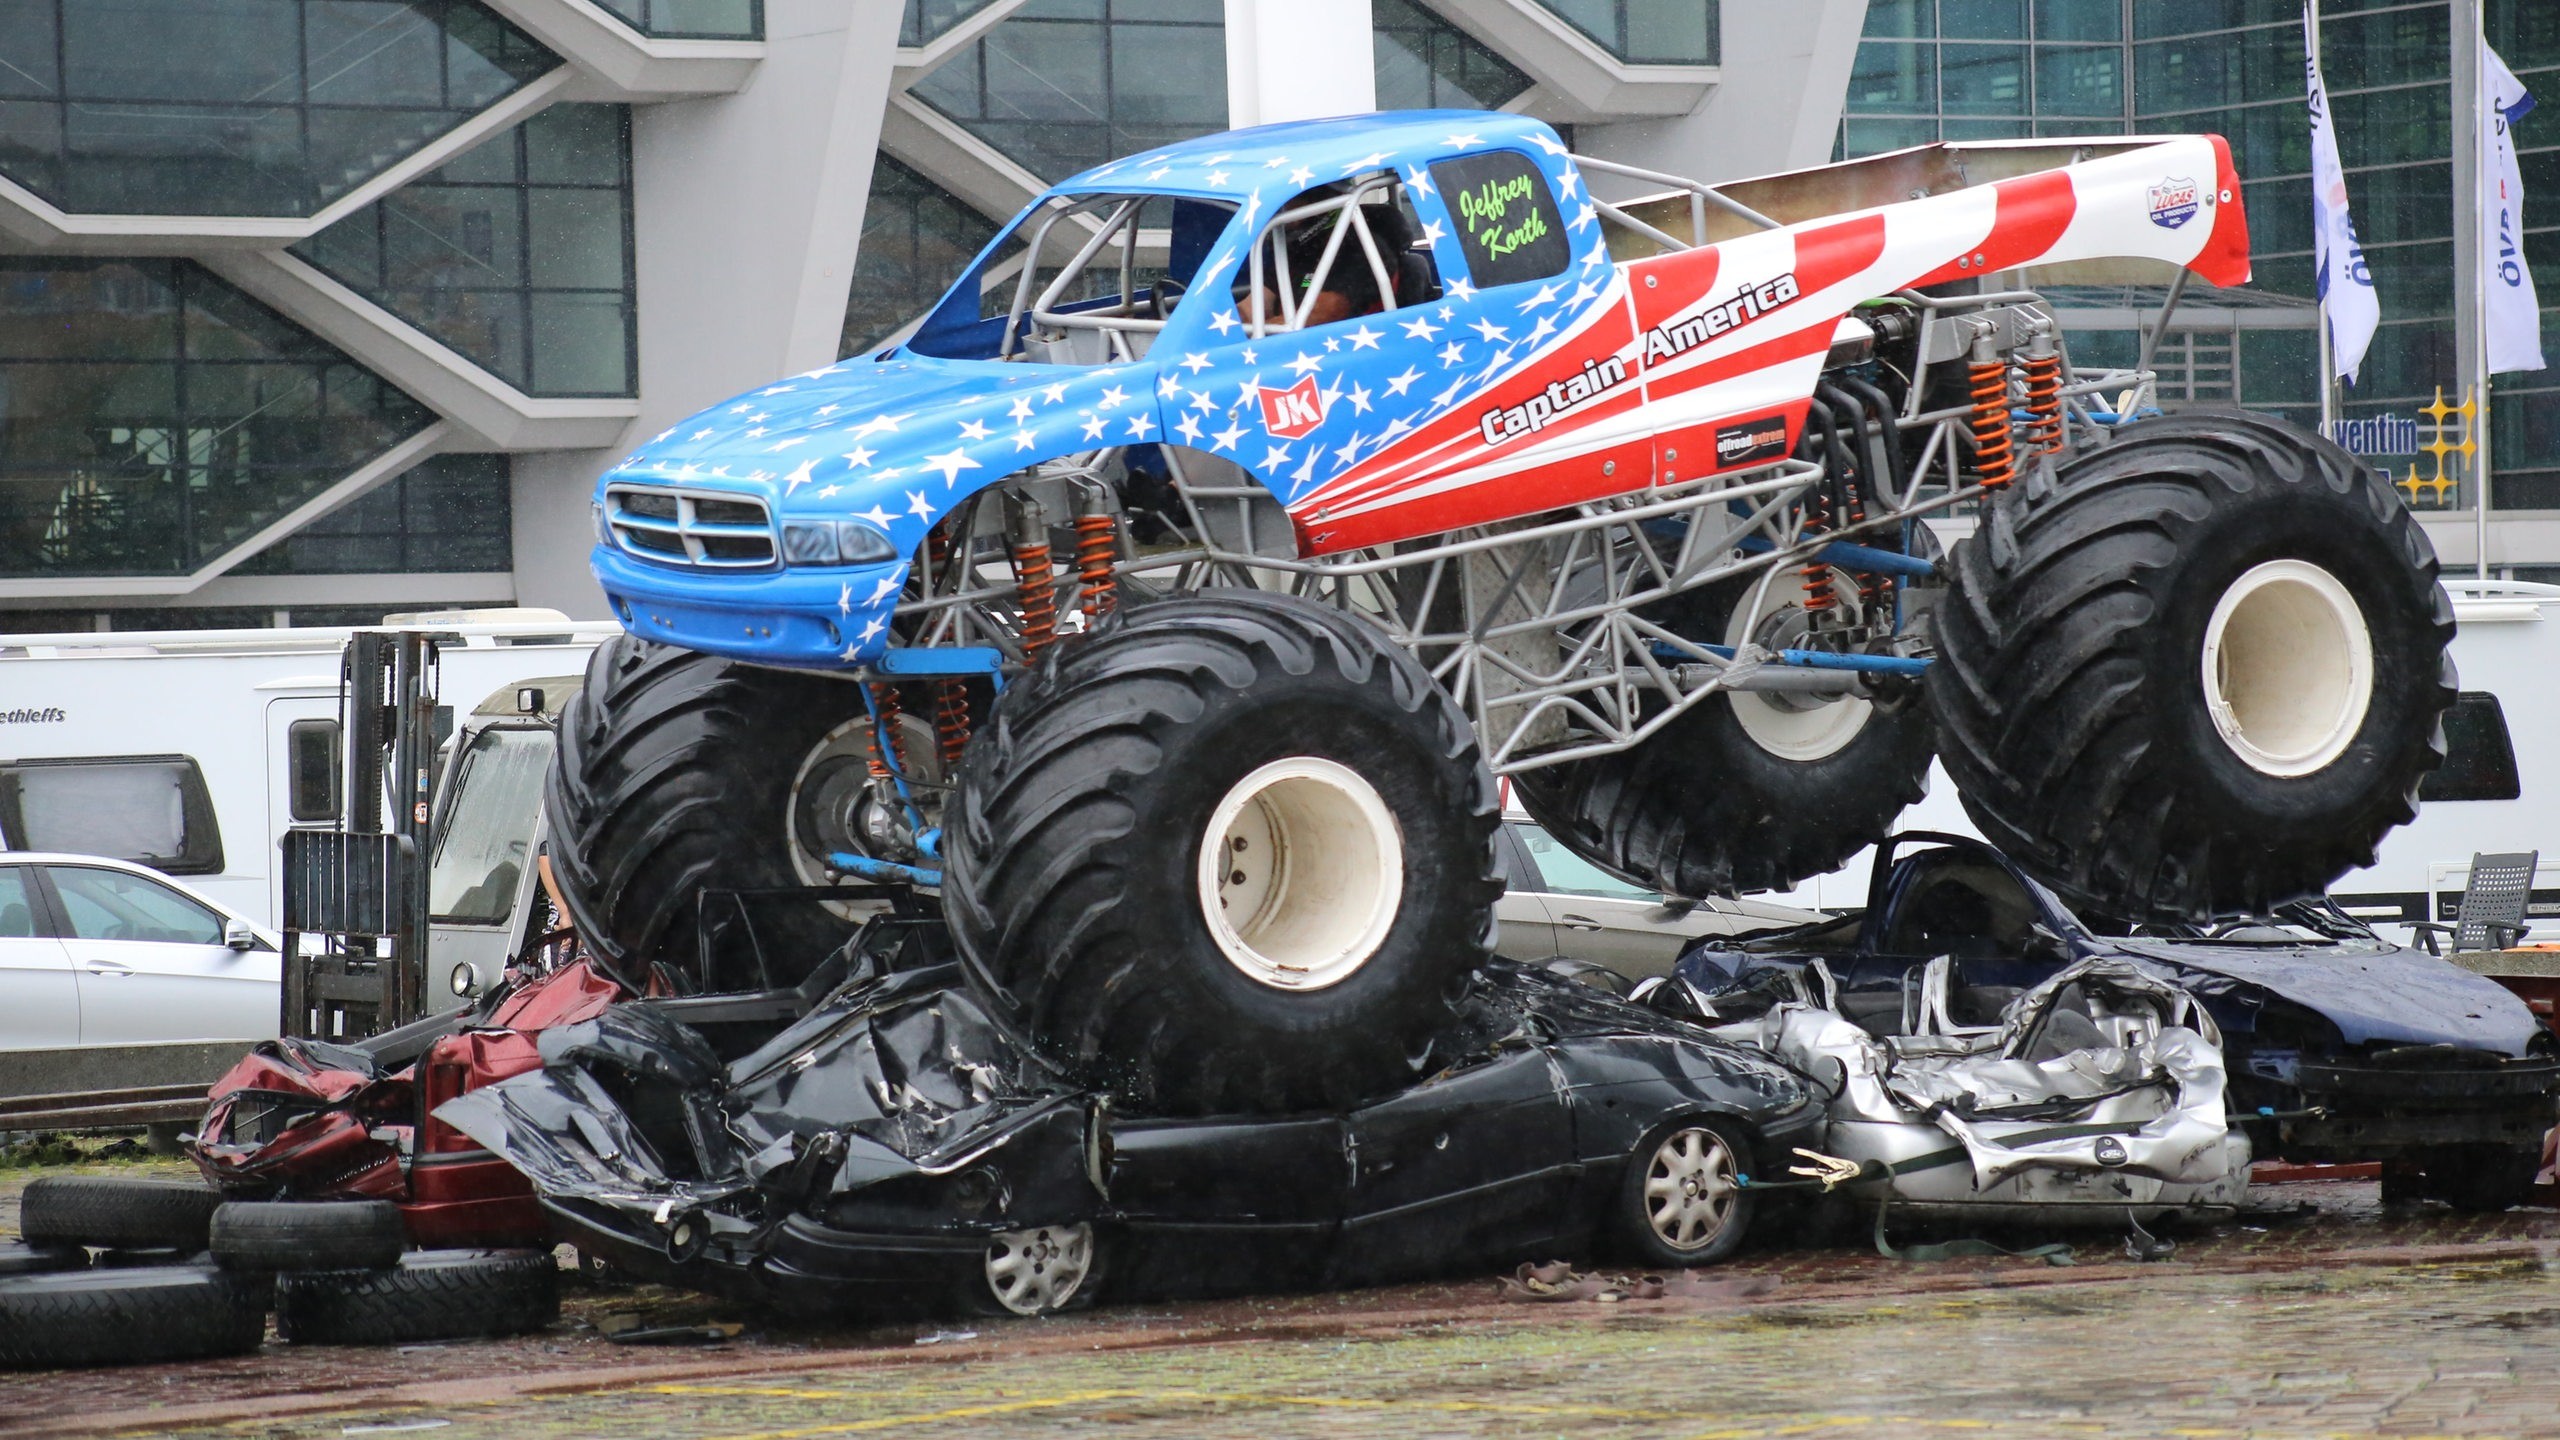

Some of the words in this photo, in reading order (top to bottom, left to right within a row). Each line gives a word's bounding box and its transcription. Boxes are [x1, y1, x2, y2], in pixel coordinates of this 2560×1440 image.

[1459, 174, 1533, 234] Jeffrey
[2155, 189, 2194, 210] LUCAS
[1480, 206, 1547, 262] Korth
[1479, 354, 1628, 446] Captain
[1643, 272, 1801, 369] America
[1270, 389, 1322, 432] JK
[2318, 412, 2418, 456] ventim
